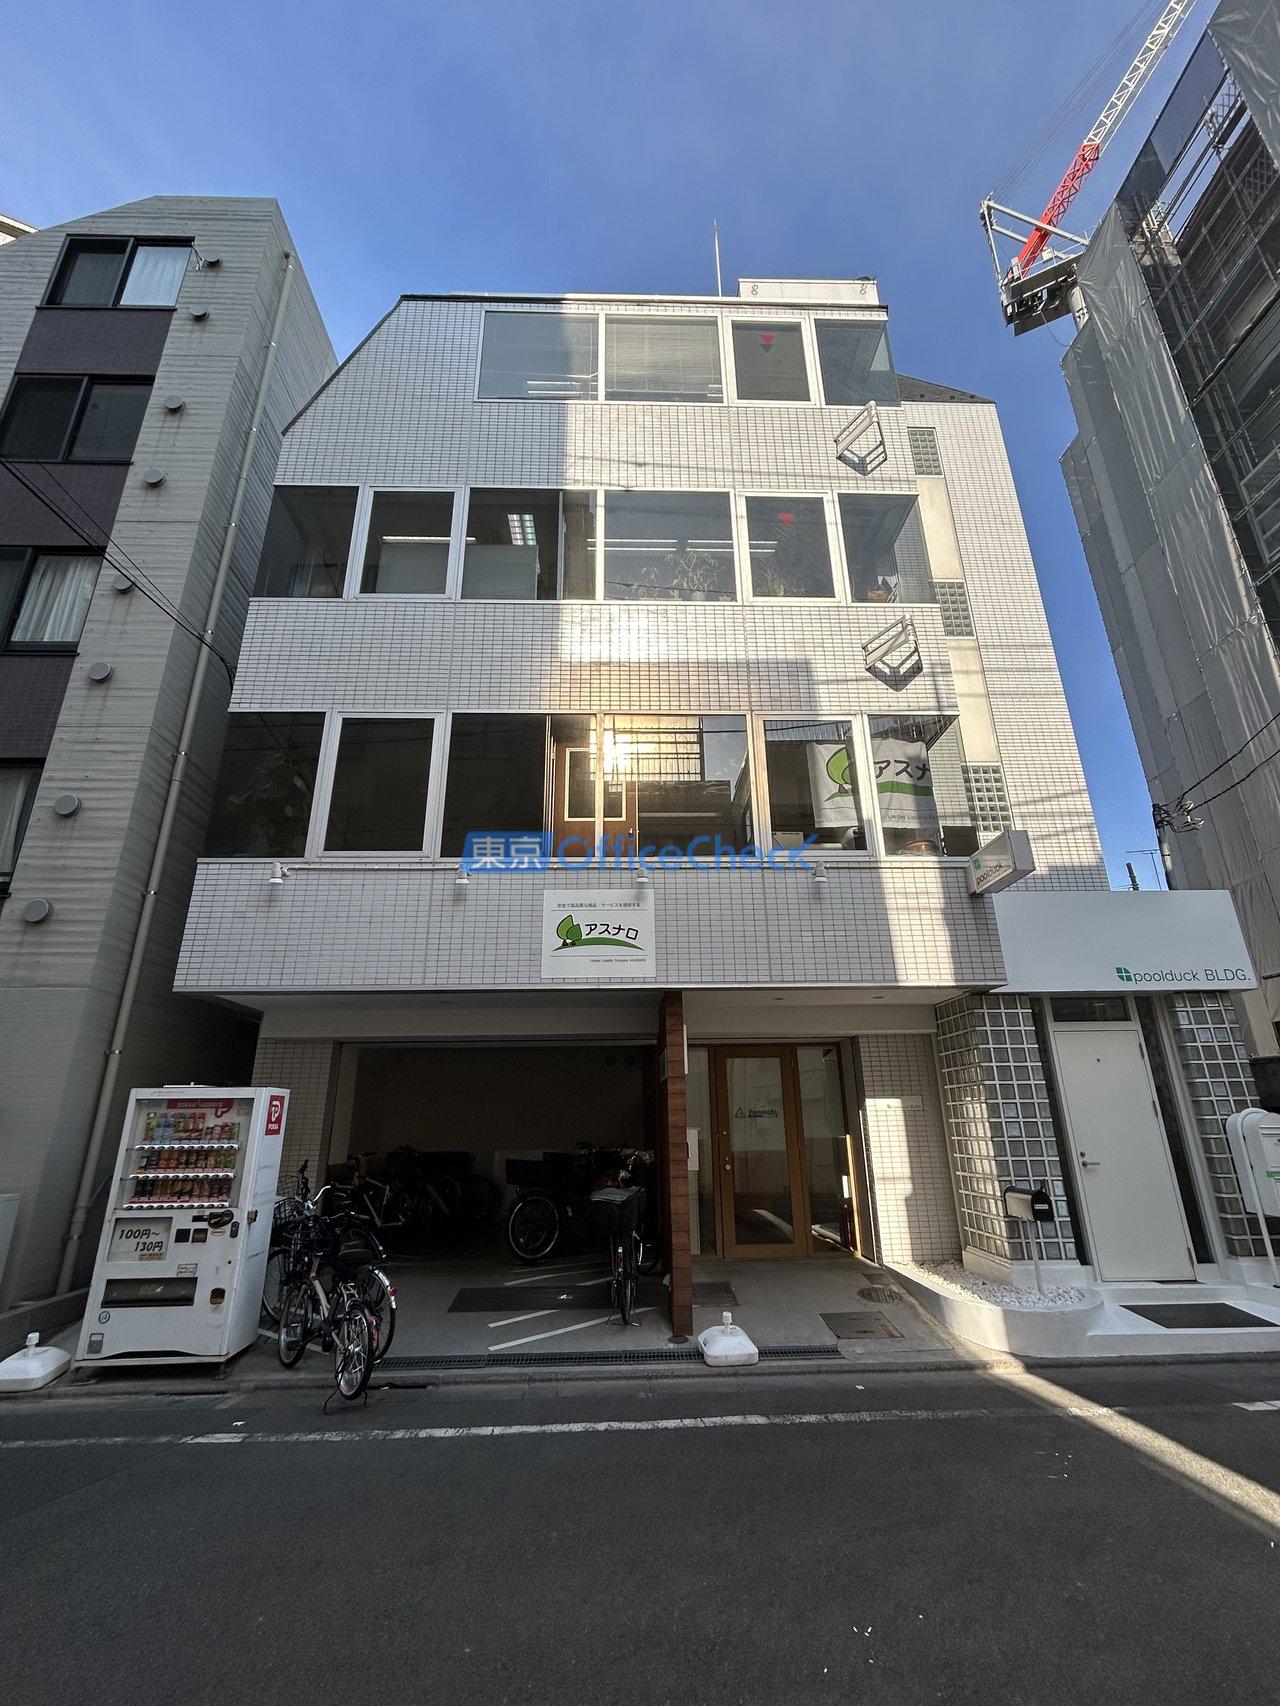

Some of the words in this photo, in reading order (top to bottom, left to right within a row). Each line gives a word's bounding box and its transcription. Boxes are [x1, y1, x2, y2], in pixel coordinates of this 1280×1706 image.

[585, 923, 639, 941] アスナロ
[1133, 969, 1200, 985] poolduck
[1204, 968, 1252, 982] BLDG.
[134, 1240, 163, 1252] 130円
